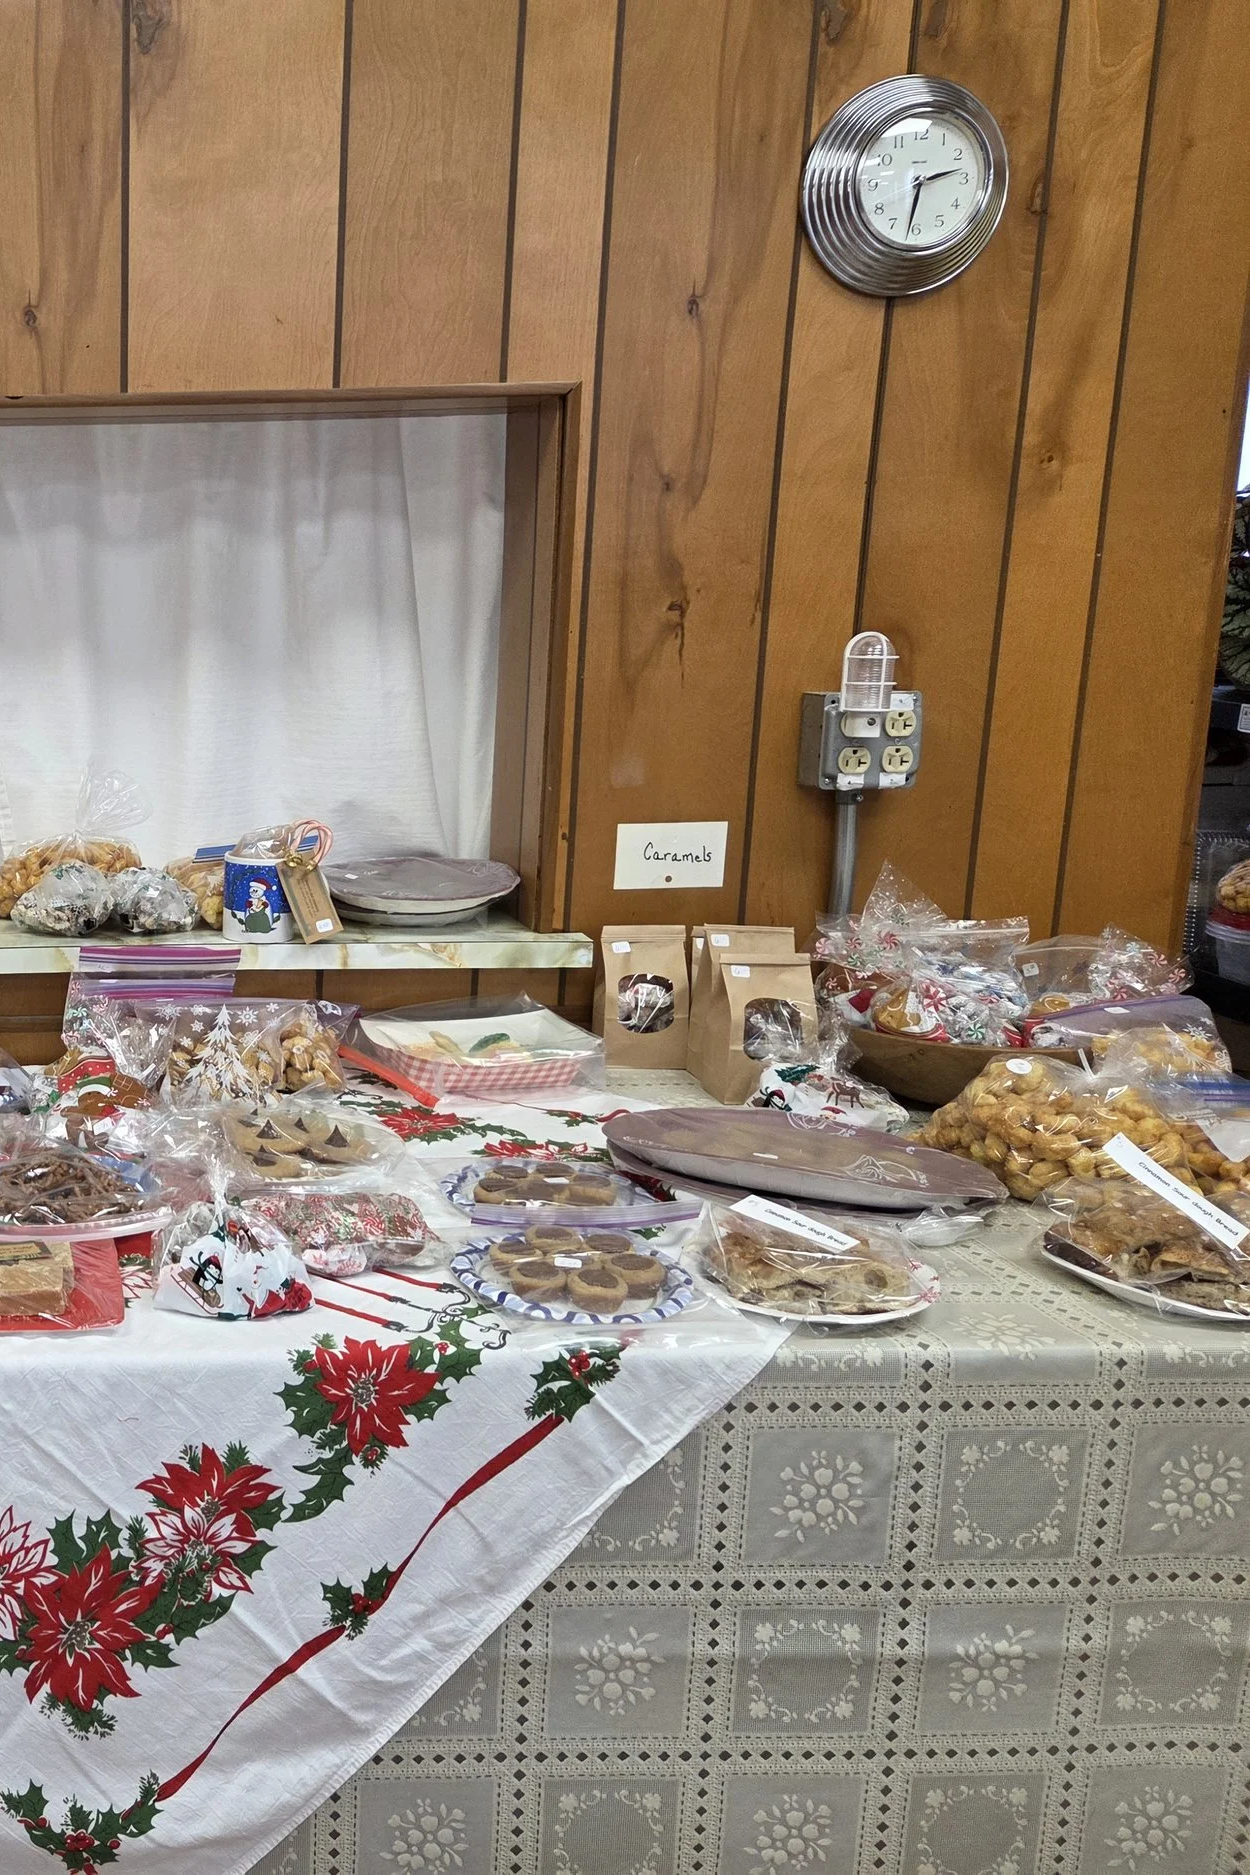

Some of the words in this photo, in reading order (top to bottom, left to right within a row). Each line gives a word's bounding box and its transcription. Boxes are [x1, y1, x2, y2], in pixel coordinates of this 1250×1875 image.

[914, 128, 929, 141] 12
[893, 135, 904, 149] 11
[953, 148, 963, 161] 2
[867, 178, 879, 192] 9
[958, 172, 969, 185] 3
[874, 202, 885, 216] 8
[950, 197, 961, 210] 4
[887, 218, 898, 230] 7
[934, 214, 945, 228] 5
[911, 223, 922, 236] 6
[643, 841, 712, 863] Caramels
[1138, 1161, 1171, 1187] Cinnamon
[1171, 1187, 1190, 1200] Sour
[1192, 1201, 1214, 1218] dough
[1215, 1218, 1239, 1236] Bread
[764, 1208, 792, 1221] Cinnamon
[791, 1219, 807, 1228] Sour
[827, 1233, 847, 1246] Bread
